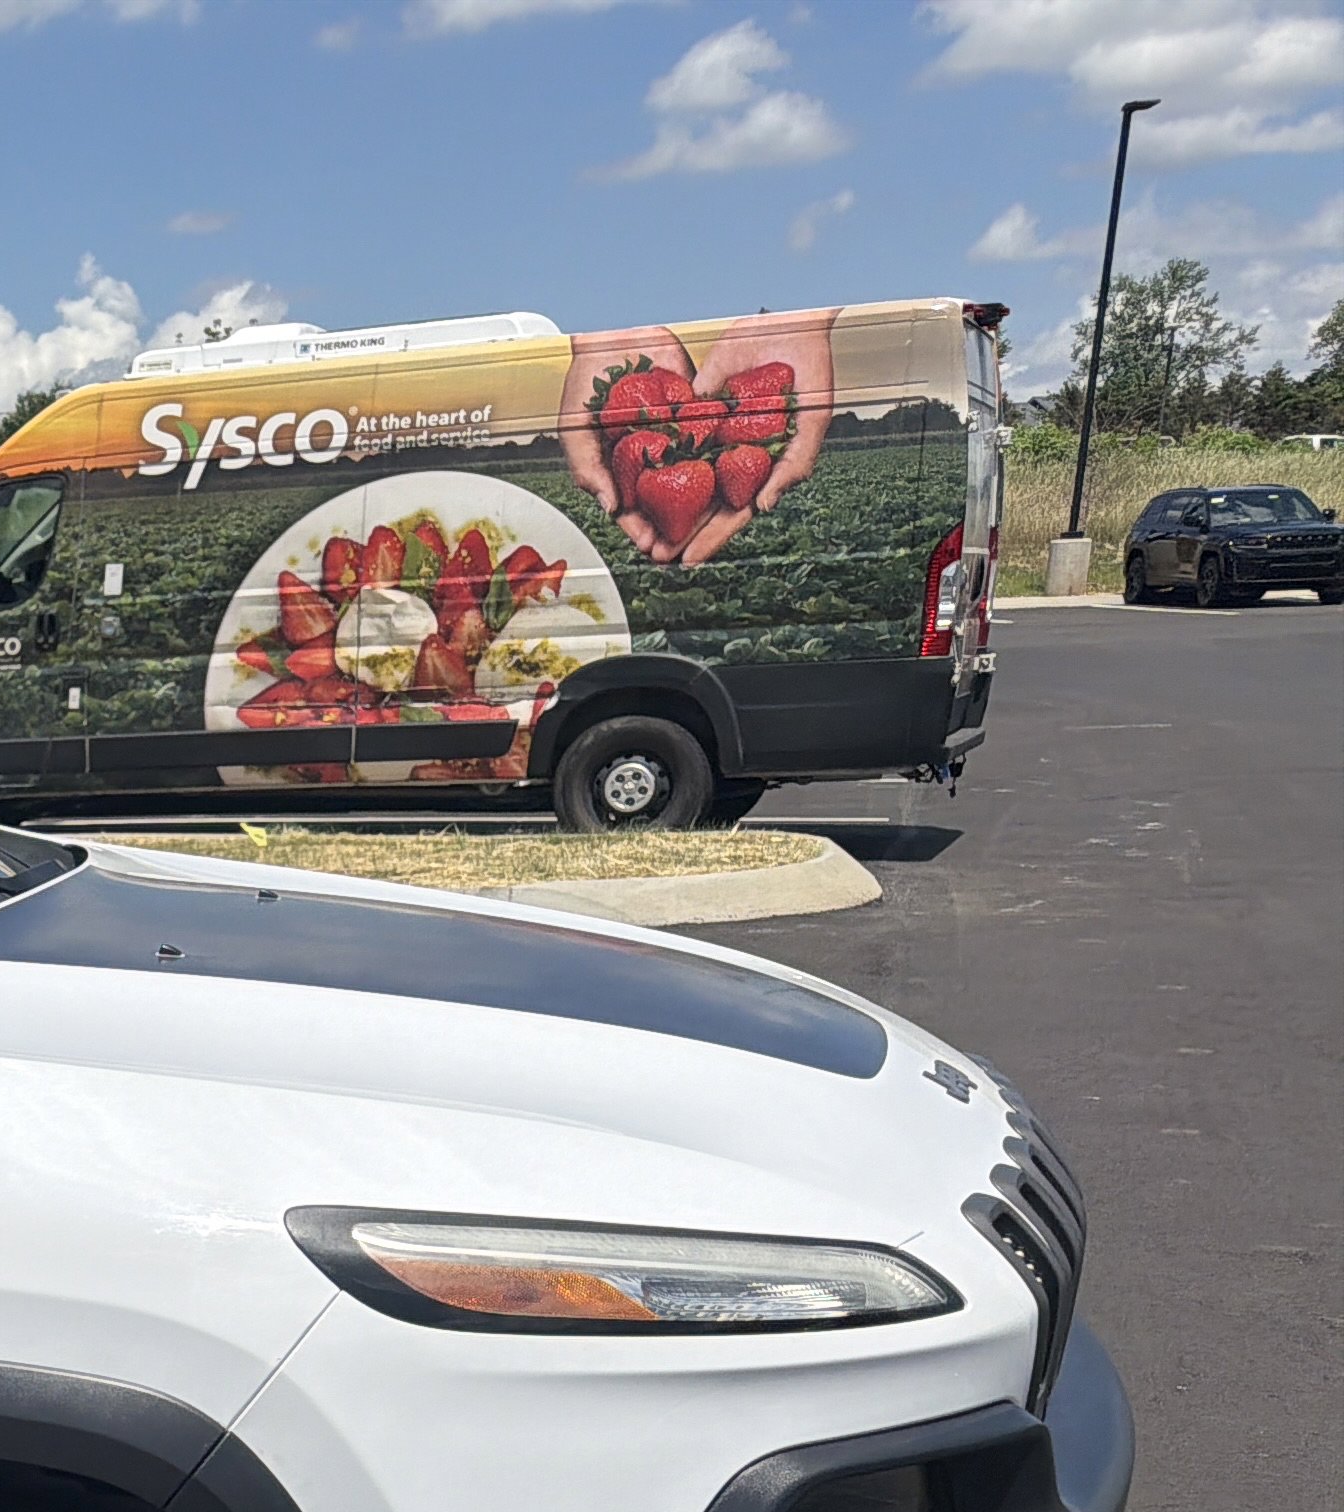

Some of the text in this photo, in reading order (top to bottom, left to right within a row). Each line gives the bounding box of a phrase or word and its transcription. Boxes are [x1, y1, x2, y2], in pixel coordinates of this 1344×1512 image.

[314, 337, 385, 352] THERMO KING
[356, 404, 493, 433] At the heart of
[353, 426, 491, 452] food and service
